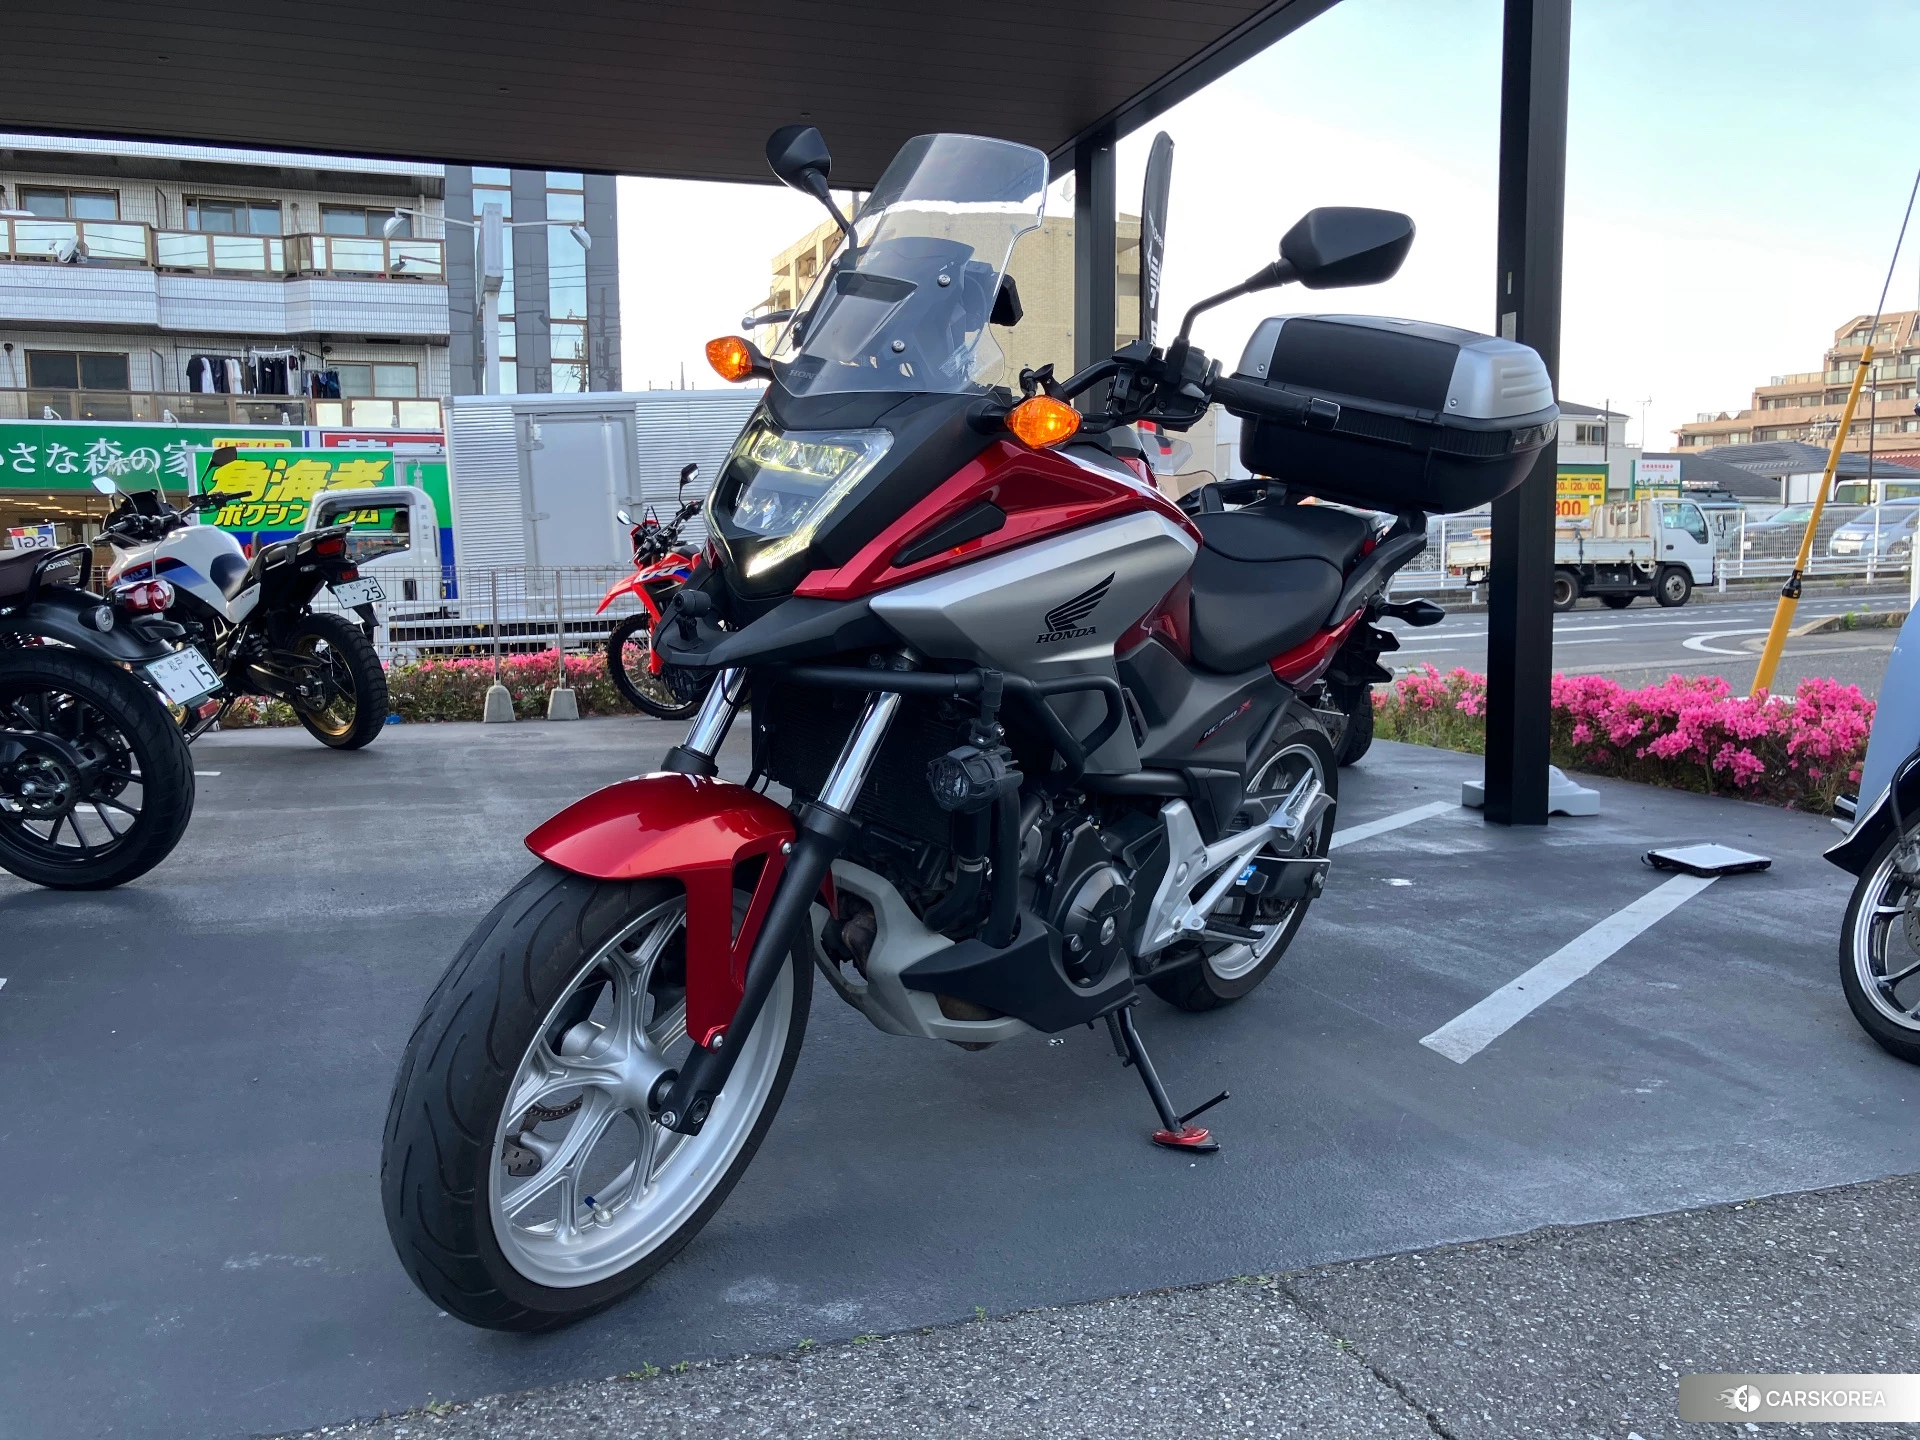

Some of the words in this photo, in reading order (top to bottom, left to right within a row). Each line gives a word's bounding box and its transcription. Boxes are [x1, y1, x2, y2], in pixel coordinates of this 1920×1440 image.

[0, 438, 195, 477] さな森の家
[1035, 626, 1097, 644] HONDA
